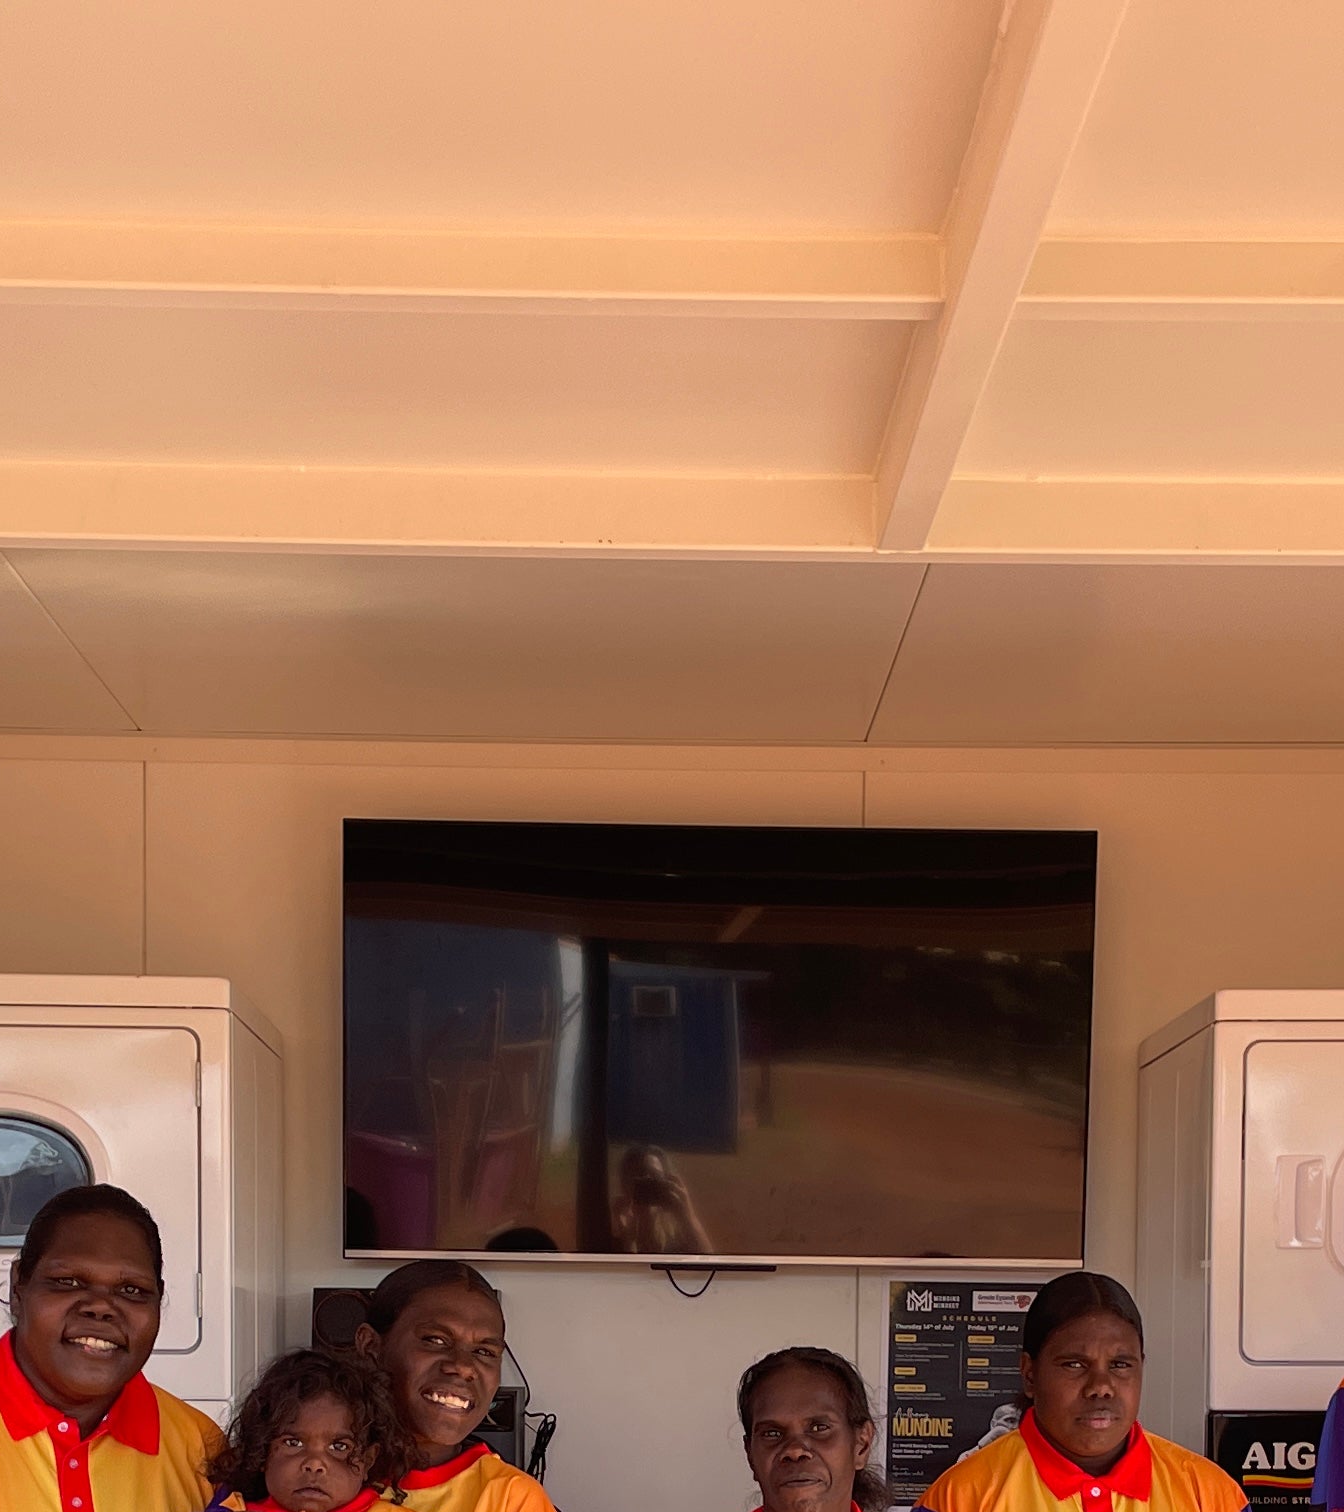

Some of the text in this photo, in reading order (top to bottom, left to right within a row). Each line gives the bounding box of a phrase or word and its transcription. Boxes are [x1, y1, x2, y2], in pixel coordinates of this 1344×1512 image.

[892, 1417, 954, 1438] MUNDINE
[1242, 1441, 1316, 1470] AIG
[1248, 1496, 1288, 1505] UILDING
